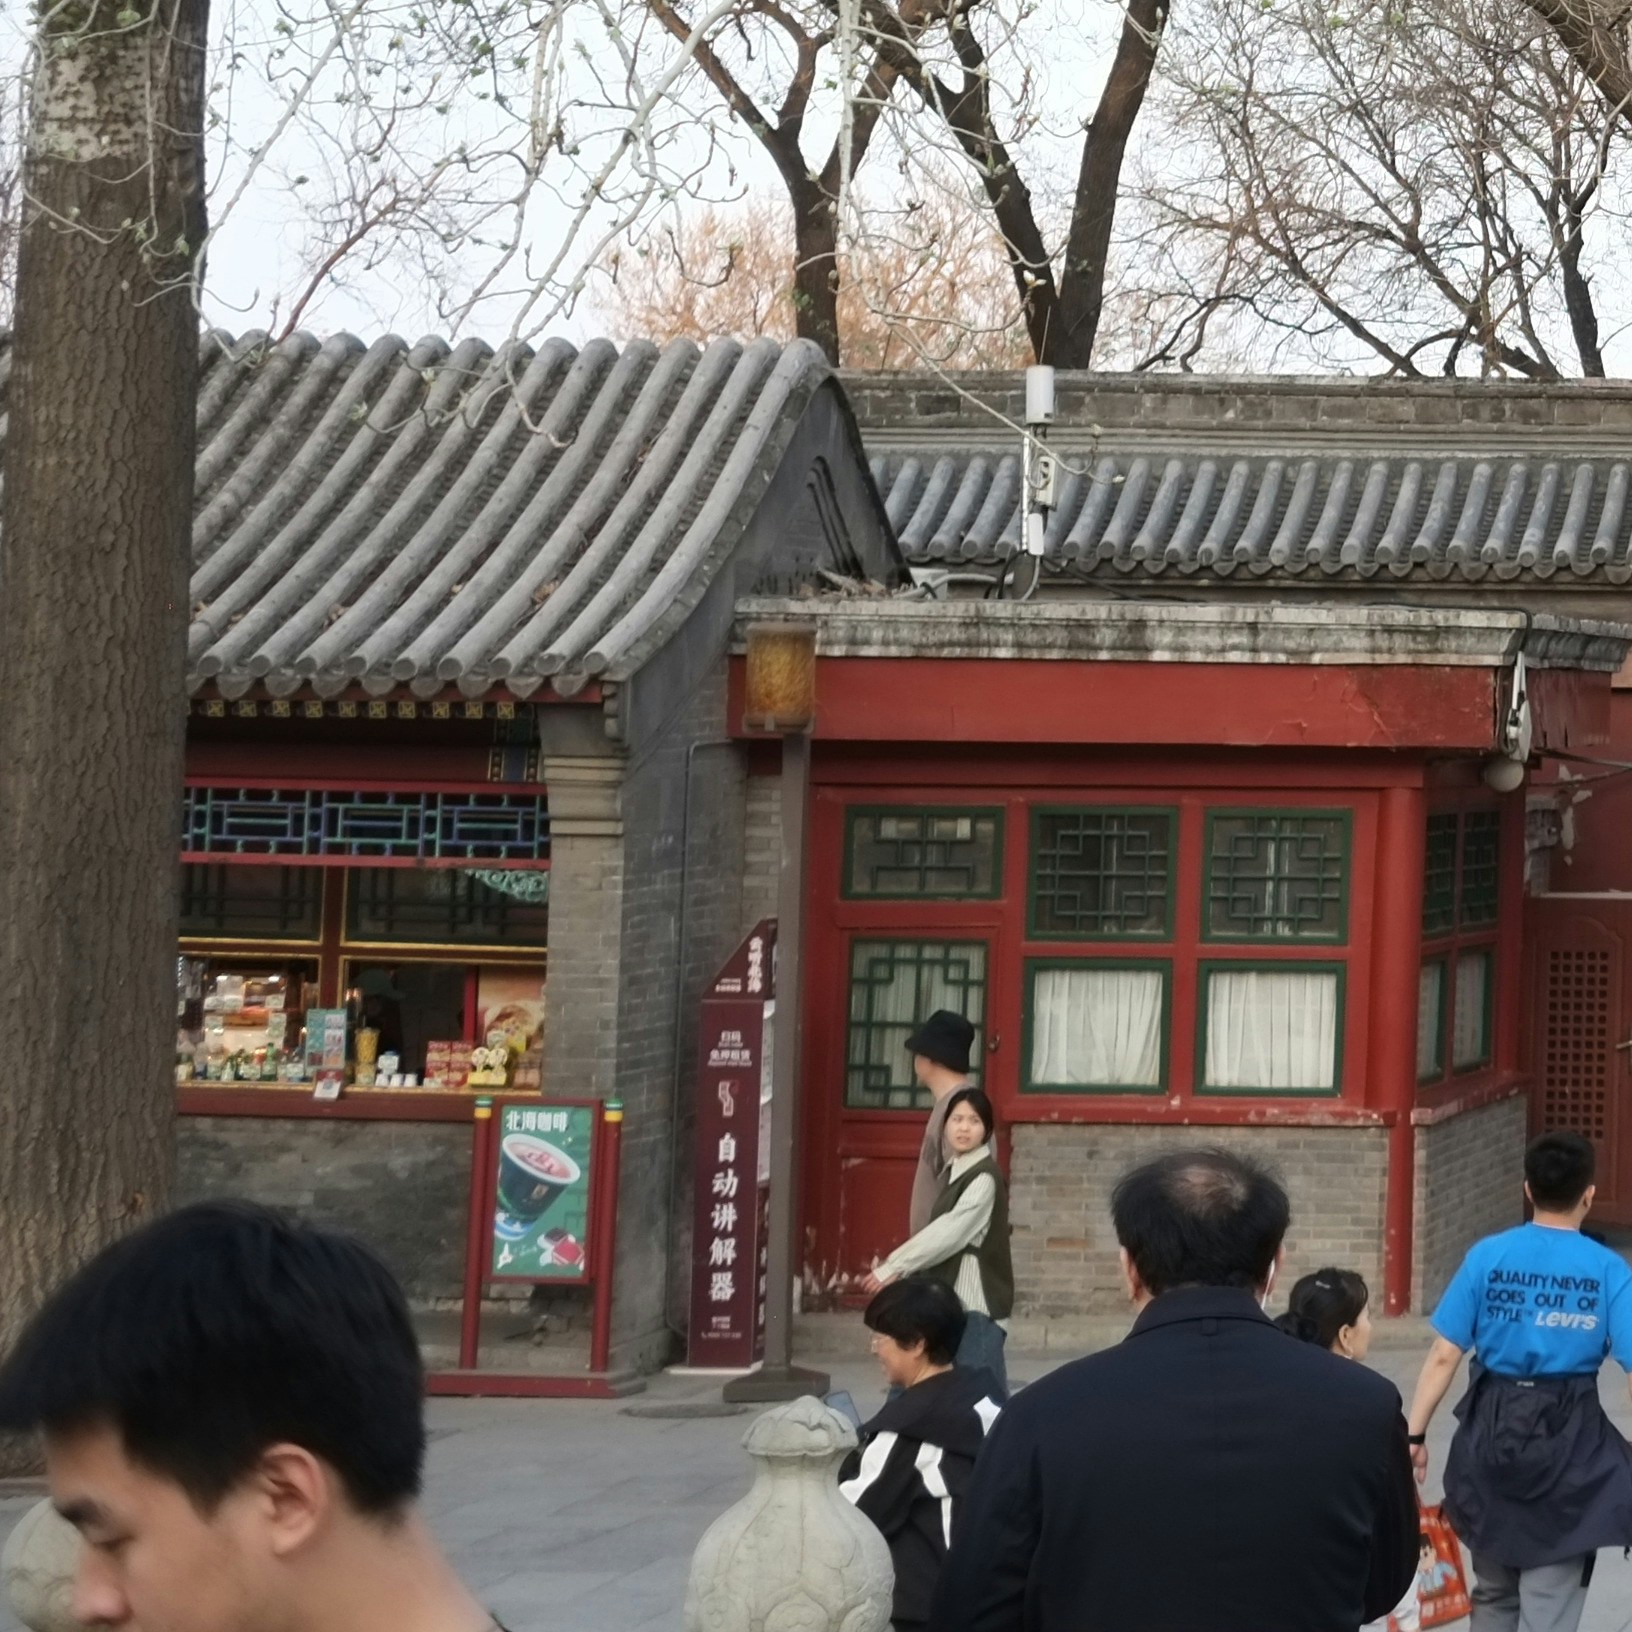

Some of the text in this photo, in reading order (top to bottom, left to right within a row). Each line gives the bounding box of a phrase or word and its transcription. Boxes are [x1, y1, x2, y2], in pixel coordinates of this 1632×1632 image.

[506, 1110, 568, 1132] 北海咖啡
[709, 1132, 739, 1302] 自动讲解器
[1488, 1270, 1600, 1293] QUALITY NEVER
[1486, 1288, 1598, 1311] GOES OUT OF
